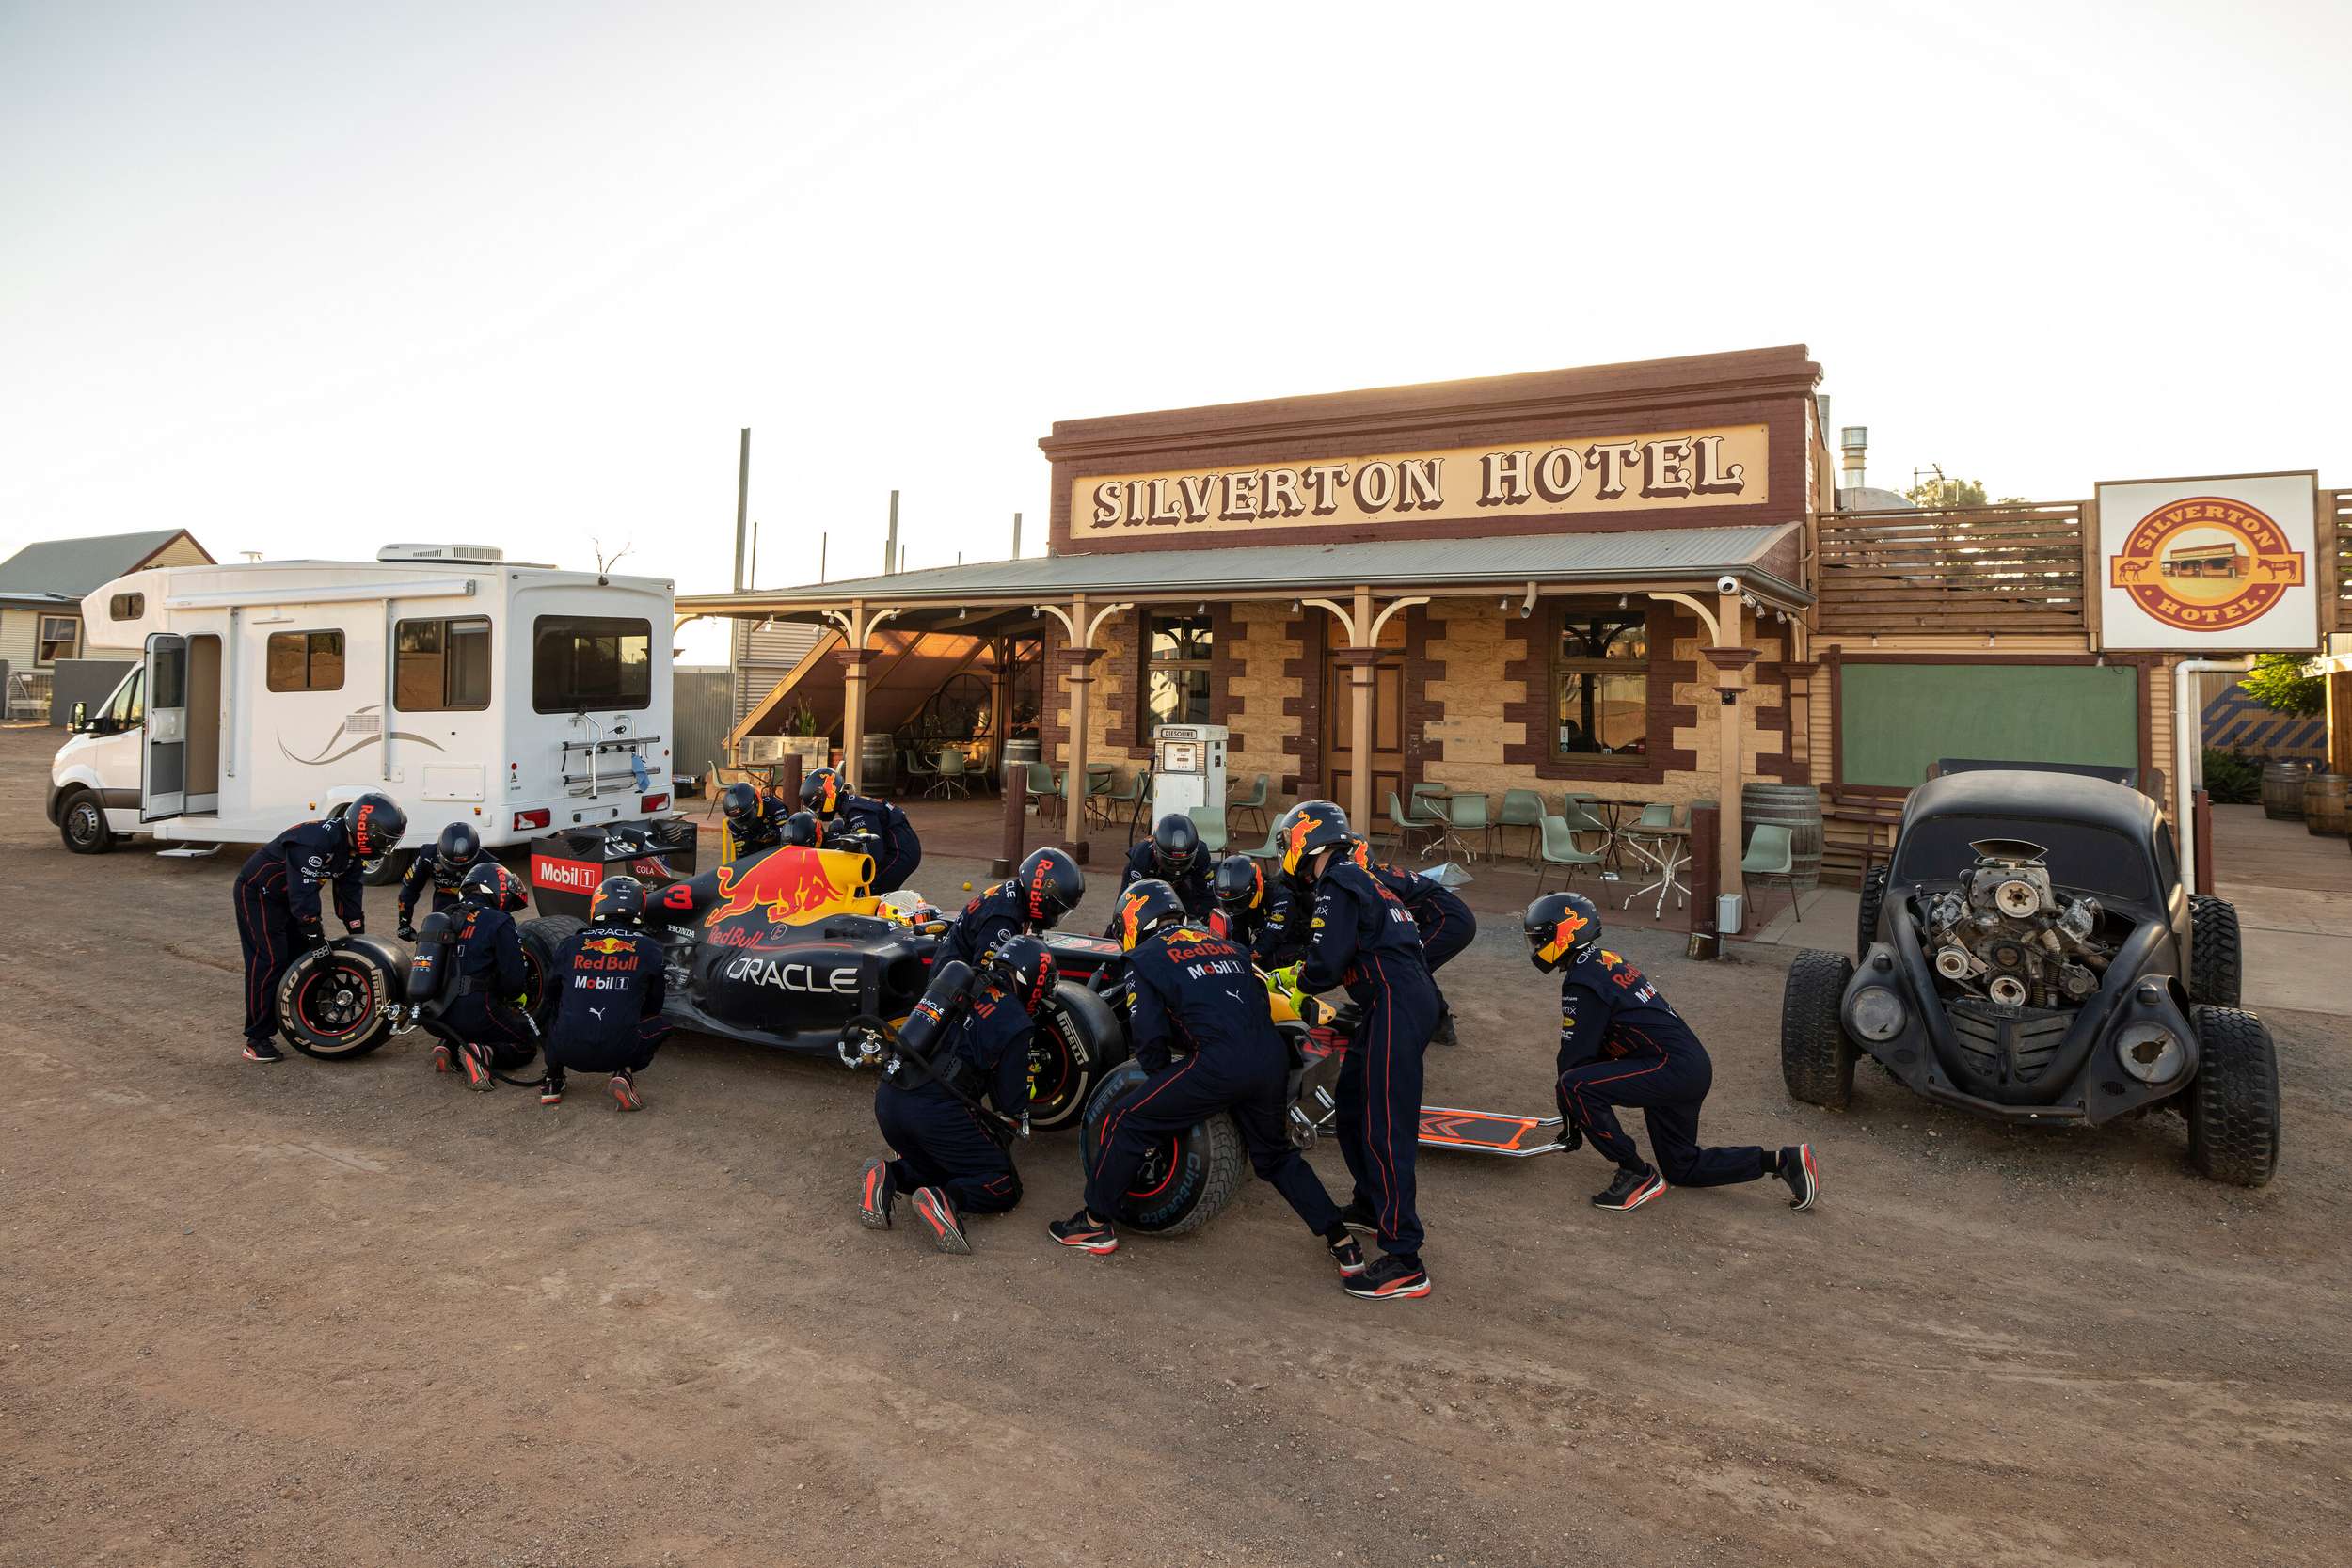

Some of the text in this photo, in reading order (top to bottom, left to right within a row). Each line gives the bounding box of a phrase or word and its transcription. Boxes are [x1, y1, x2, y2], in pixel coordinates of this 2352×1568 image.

[1089, 436, 1744, 530] SILVERTON HOTEL
[2137, 505, 2275, 550] SILVERTON
[2157, 597, 2259, 623] HOTEL
[1165, 730, 1194, 738] DIESOLINE
[541, 863, 579, 886] Mobil
[636, 865, 654, 875] COLA
[663, 884, 693, 910] 3
[1005, 880, 1016, 898] CLE
[667, 925, 695, 939] HONDA
[707, 924, 765, 949] Red Bull
[573, 954, 640, 971] Red Bull
[1166, 943, 1208, 964] Red
[725, 958, 860, 994] ORACLE
[1187, 960, 1232, 980] Mobil
[575, 975, 612, 990] Mobil
[280, 970, 299, 1031] ZERO
[919, 997, 945, 1015] RACLE
[1055, 1009, 1089, 1065] PIRELLI
